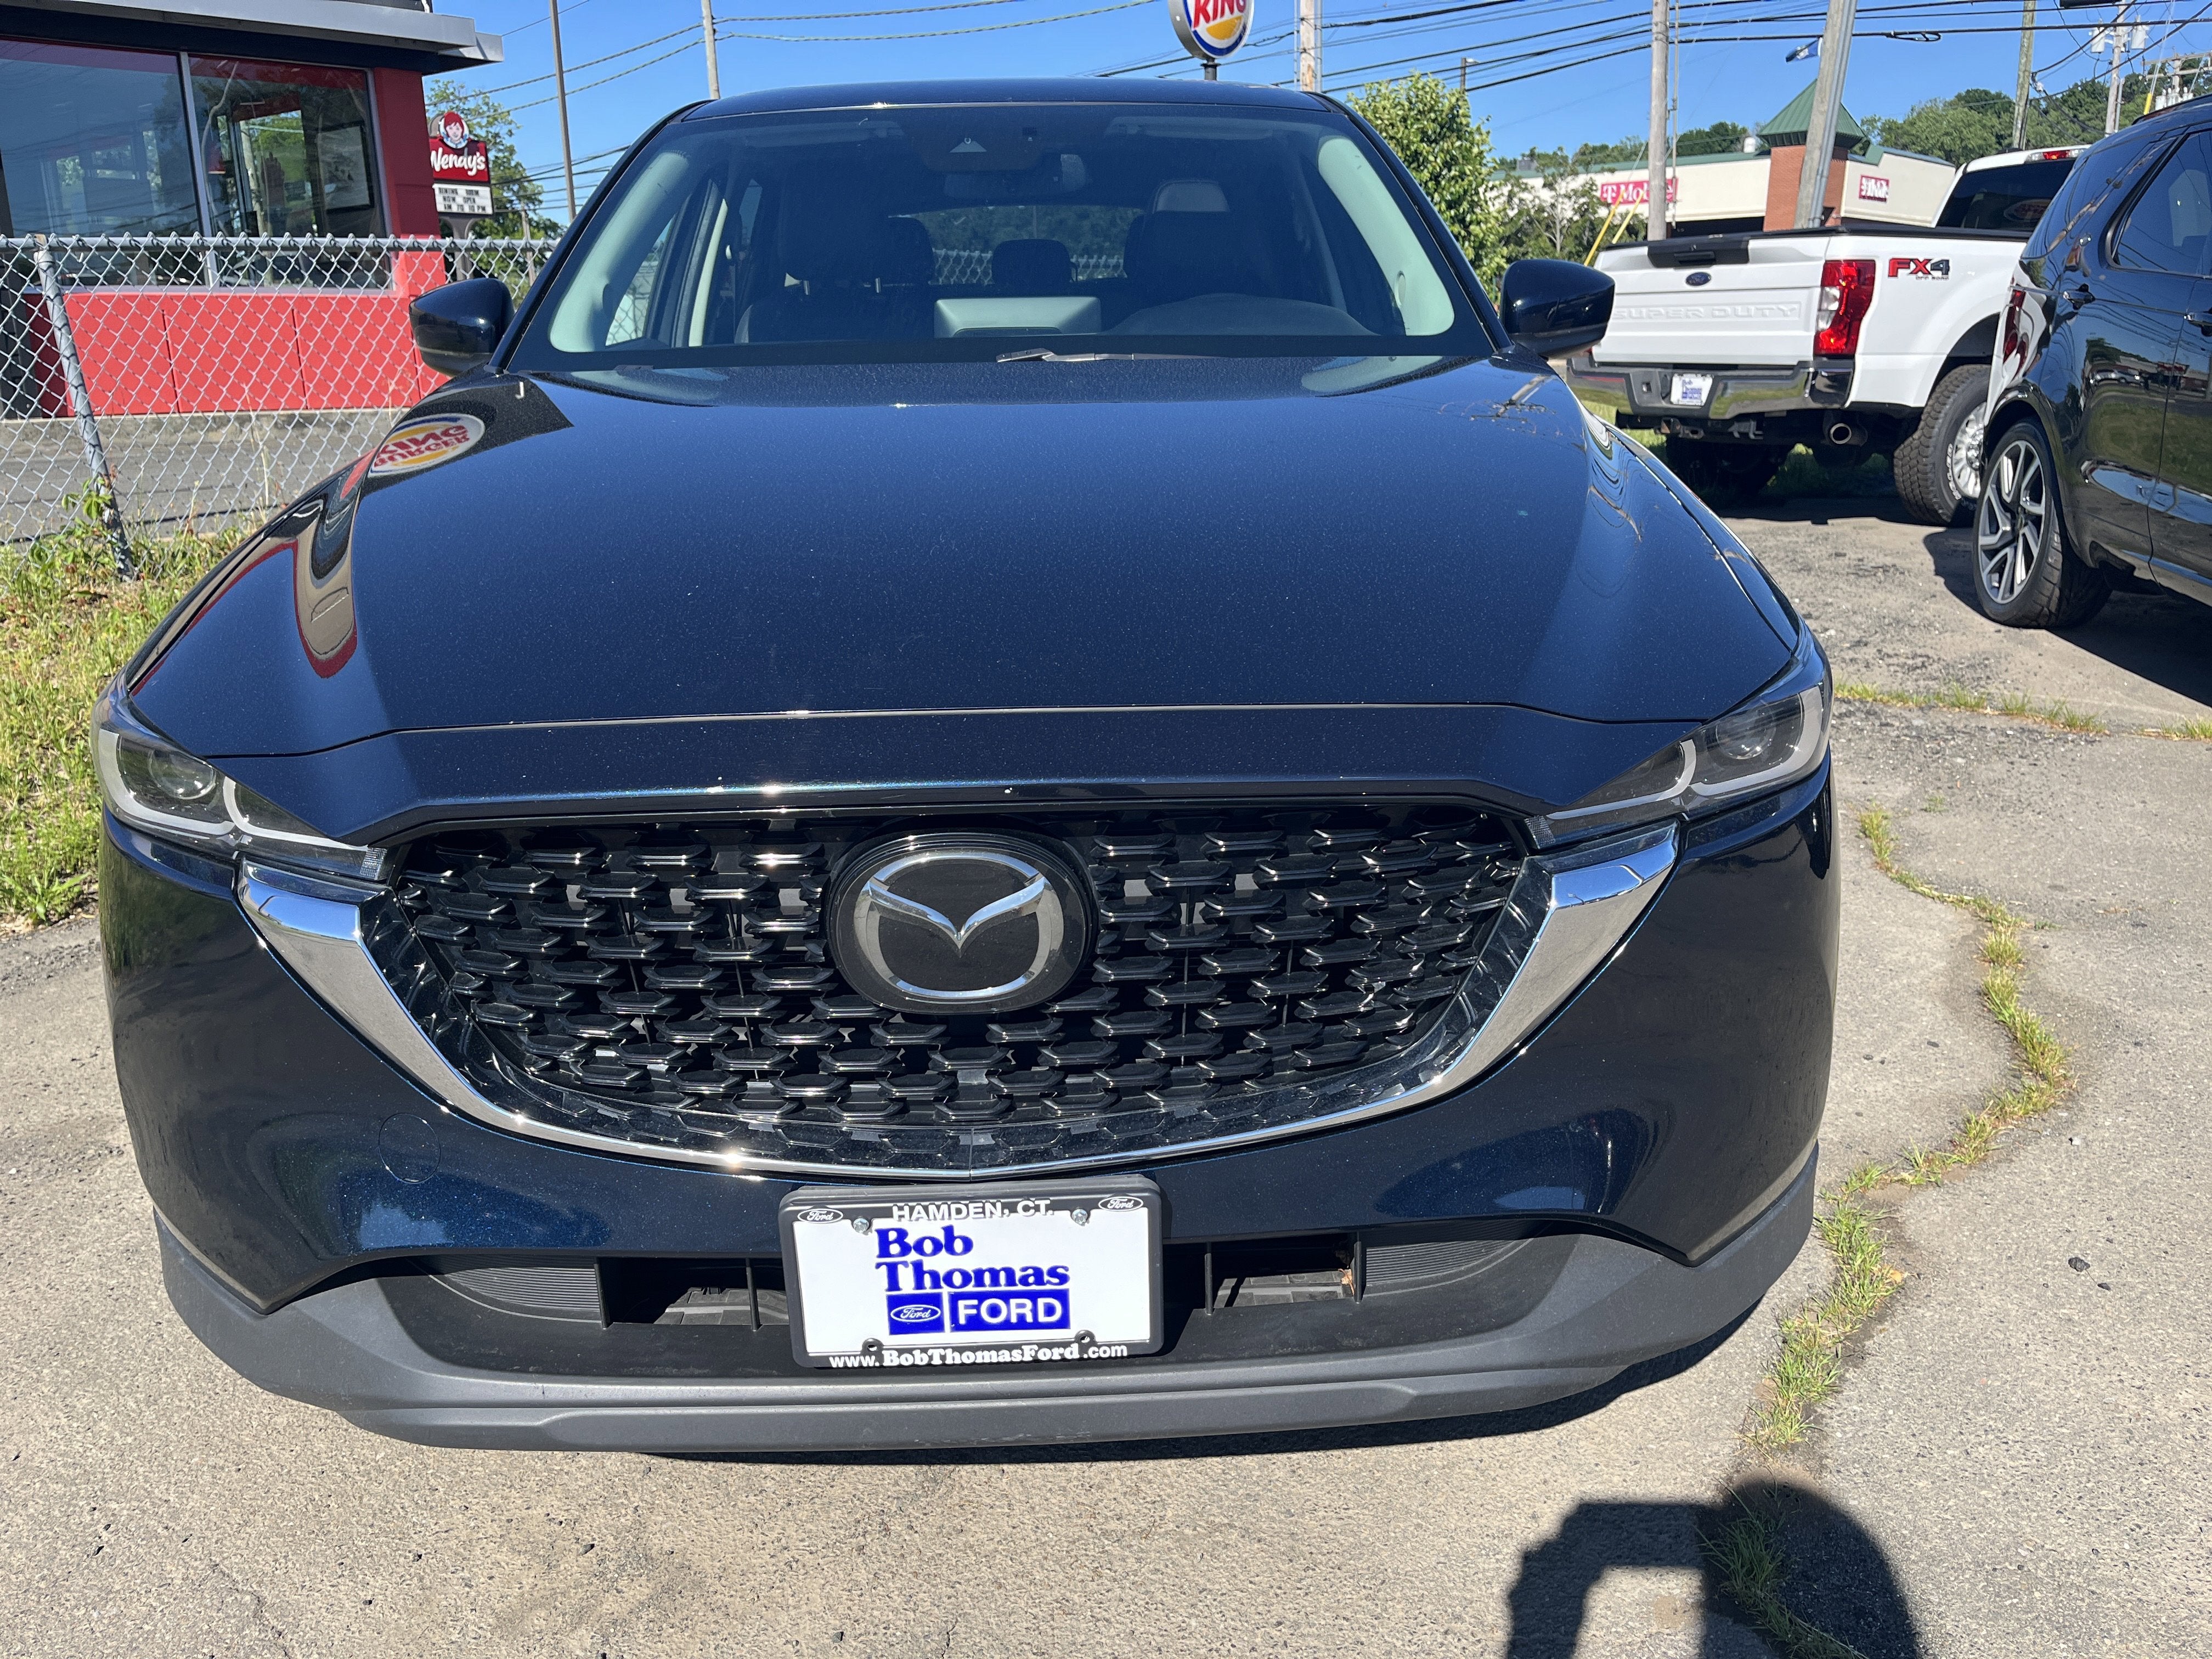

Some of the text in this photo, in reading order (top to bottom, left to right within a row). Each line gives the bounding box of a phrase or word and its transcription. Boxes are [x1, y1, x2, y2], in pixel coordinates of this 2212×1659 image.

[1888, 257, 1950, 277] FX4
[1612, 304, 1797, 320] SUPER DUTY
[892, 1199, 1054, 1221] HAMDEN, CT.
[1107, 1198, 1135, 1209] Ford
[806, 1210, 834, 1222] Ford
[874, 1224, 974, 1259] Bob
[875, 1259, 1070, 1292] Thomas
[900, 1297, 1062, 1325] Ford FORD
[829, 1343, 1127, 1368] www.BobThomasFord.com
